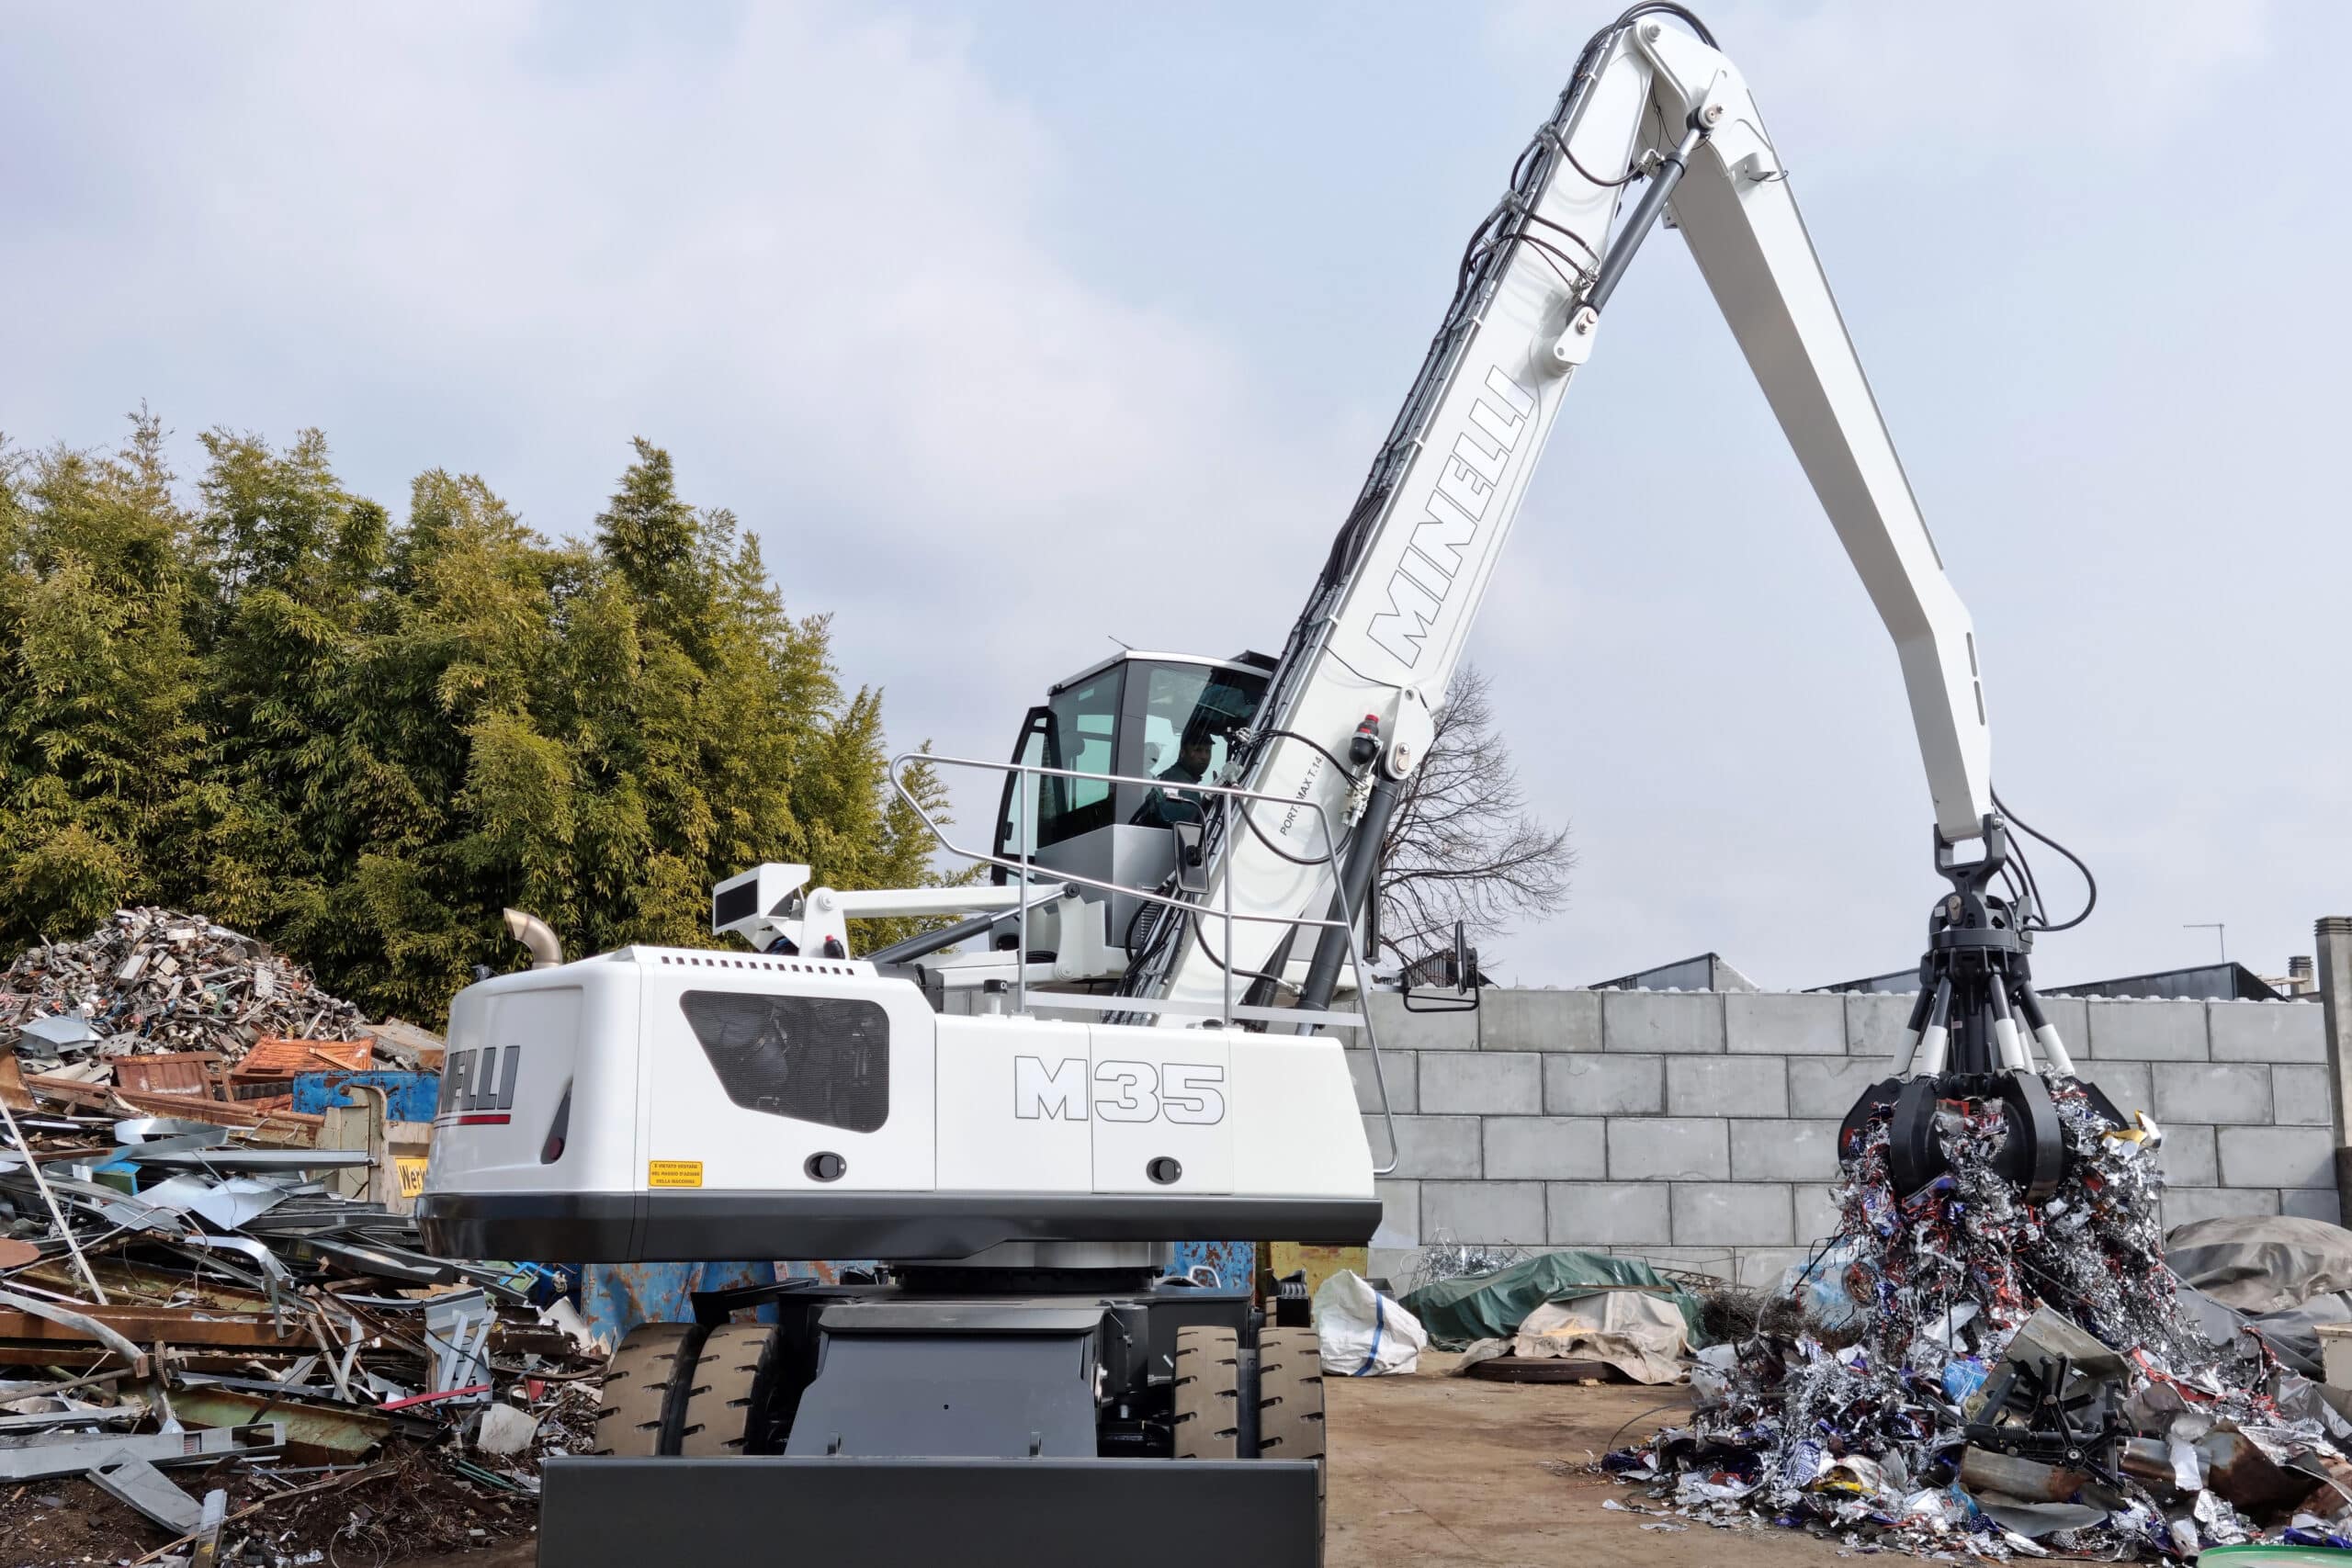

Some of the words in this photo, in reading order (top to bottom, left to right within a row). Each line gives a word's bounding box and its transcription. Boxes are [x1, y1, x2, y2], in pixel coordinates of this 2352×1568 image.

[1366, 365, 1535, 670] MINELLI
[1295, 777, 1313, 800] MAX
[1014, 1055, 1226, 1125] M35
